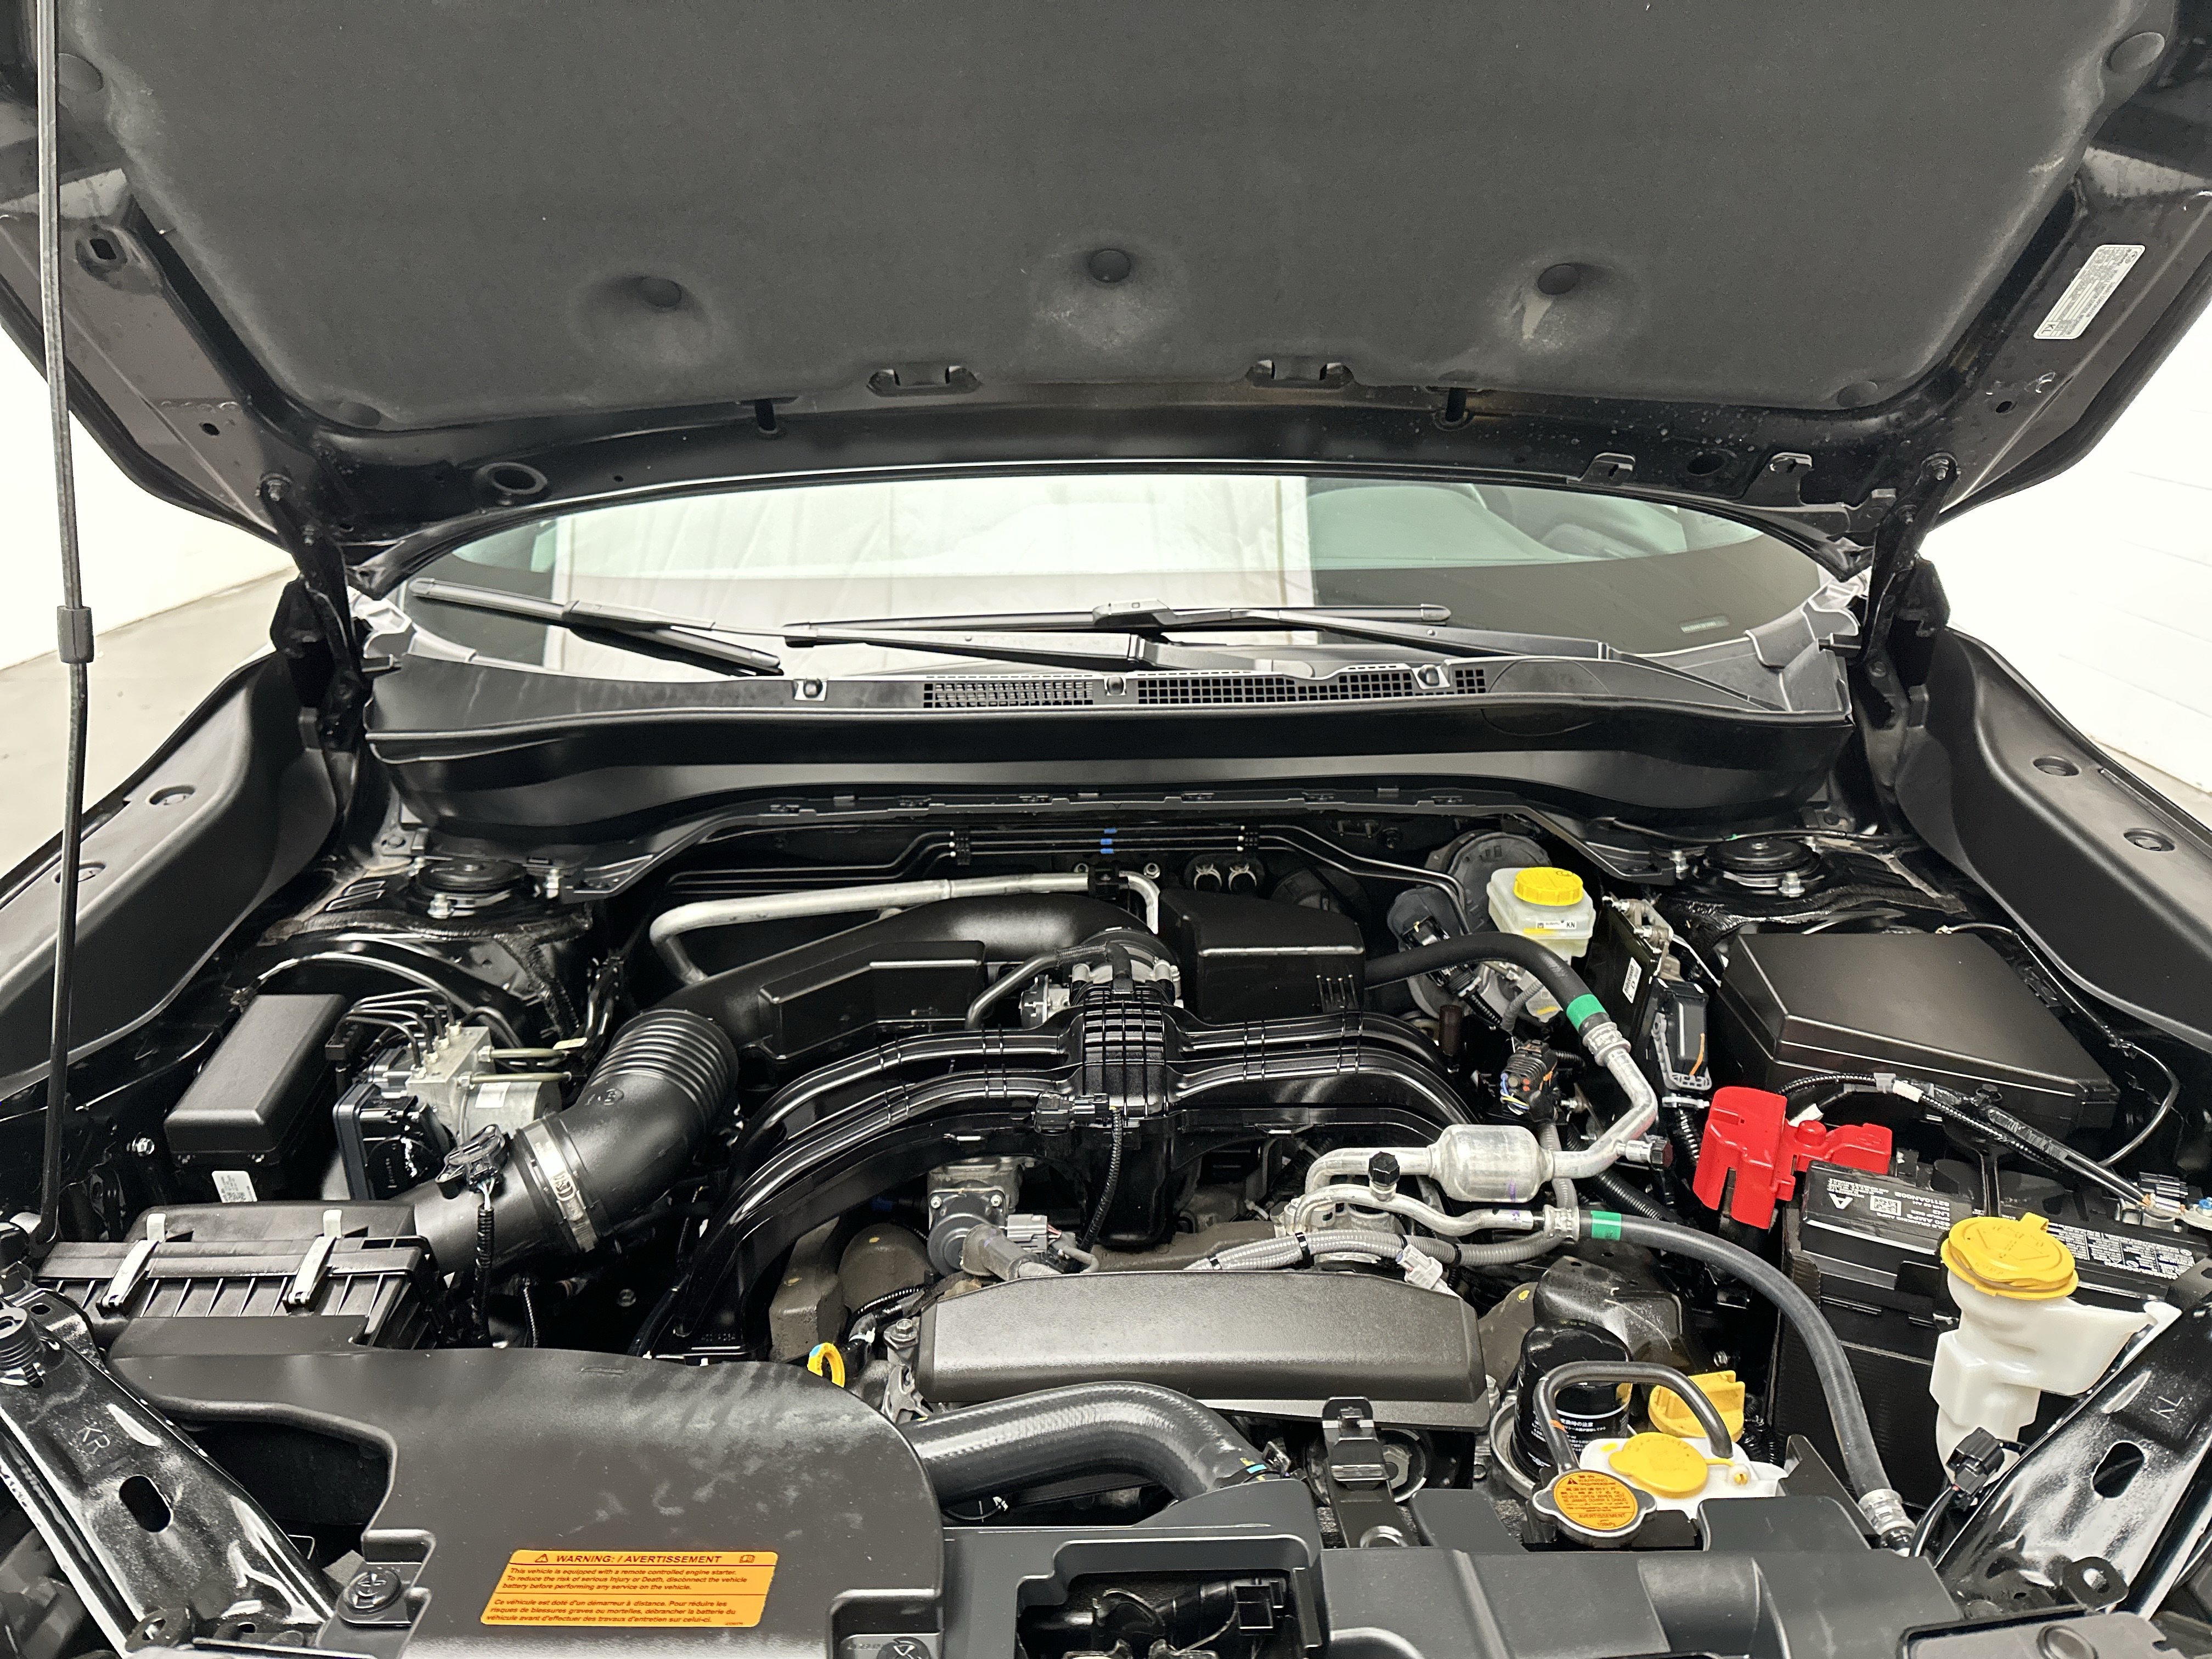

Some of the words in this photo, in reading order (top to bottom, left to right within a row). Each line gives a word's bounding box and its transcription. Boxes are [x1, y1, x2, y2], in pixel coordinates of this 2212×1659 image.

[2041, 324, 2054, 334] KL
[1829, 1193, 1854, 1210] A
[1906, 1214, 1933, 1223] AMPS
[76, 1426, 110, 1454] KR
